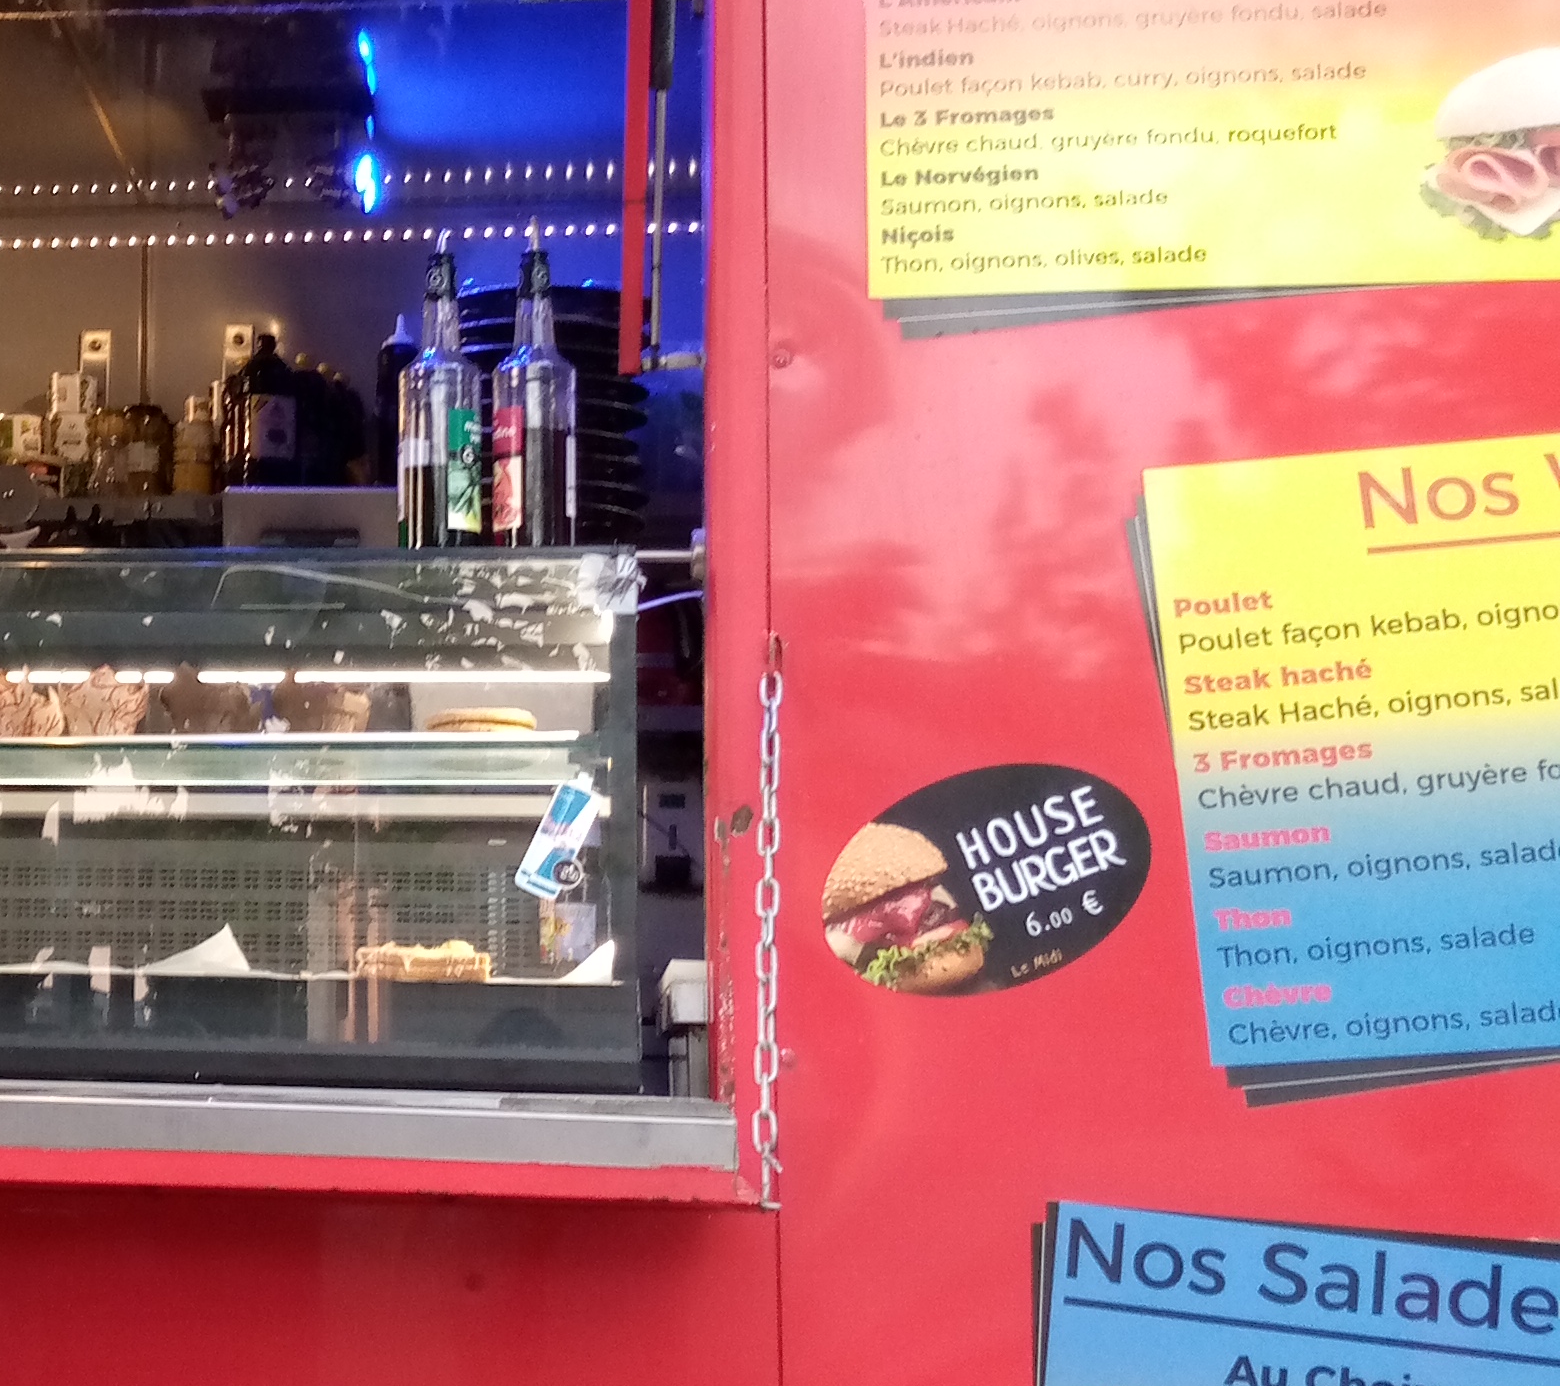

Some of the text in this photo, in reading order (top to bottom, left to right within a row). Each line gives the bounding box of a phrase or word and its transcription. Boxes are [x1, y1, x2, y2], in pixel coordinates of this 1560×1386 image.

[878, 17, 941, 37] Steak
[1311, 0, 1388, 19] salade
[879, 49, 975, 70] L'indien
[880, 61, 1368, 99] Poulet façon kebab, curry, oignons, salade
[880, 106, 1056, 128] Le 3 Fromages
[880, 134, 960, 156] Chèvre
[1050, 128, 1139, 153] gruyère
[1146, 126, 1220, 145] fondu,
[1227, 122, 1338, 146] roquefort
[881, 164, 1040, 187] Le Norvégien
[882, 188, 1169, 215] Saumon, oignons, salade
[882, 223, 955, 249] Niçois
[884, 244, 1208, 273] Thon, oignons, olives, salade
[1357, 466, 1521, 530] Nos
[1173, 590, 1273, 619] Poulet
[1179, 602, 1559, 654] Poulet façon kebab, oigno
[1184, 658, 1373, 695] Steak haché
[1188, 677, 1558, 732] Steak Haché, oignons, sal
[1193, 742, 1374, 773] 3 Fromages
[1198, 784, 1299, 809] Chèvre
[1308, 772, 1408, 799] chaud,
[1416, 763, 1528, 796] gruyère
[955, 784, 1105, 870] HOUSE
[1203, 825, 1331, 853] Saumon
[971, 829, 1127, 912] BURGER
[1208, 838, 1560, 889] Saumon, oignons, salad
[1025, 906, 1074, 937] 6.00
[1212, 908, 1292, 931] Thon
[1217, 923, 1535, 969] Thon, oignons, salade
[1223, 982, 1332, 1009] Chèvre
[1228, 999, 1560, 1046] Chèvre, oignons, salad
[1065, 1217, 1560, 1336] Nos Salade
